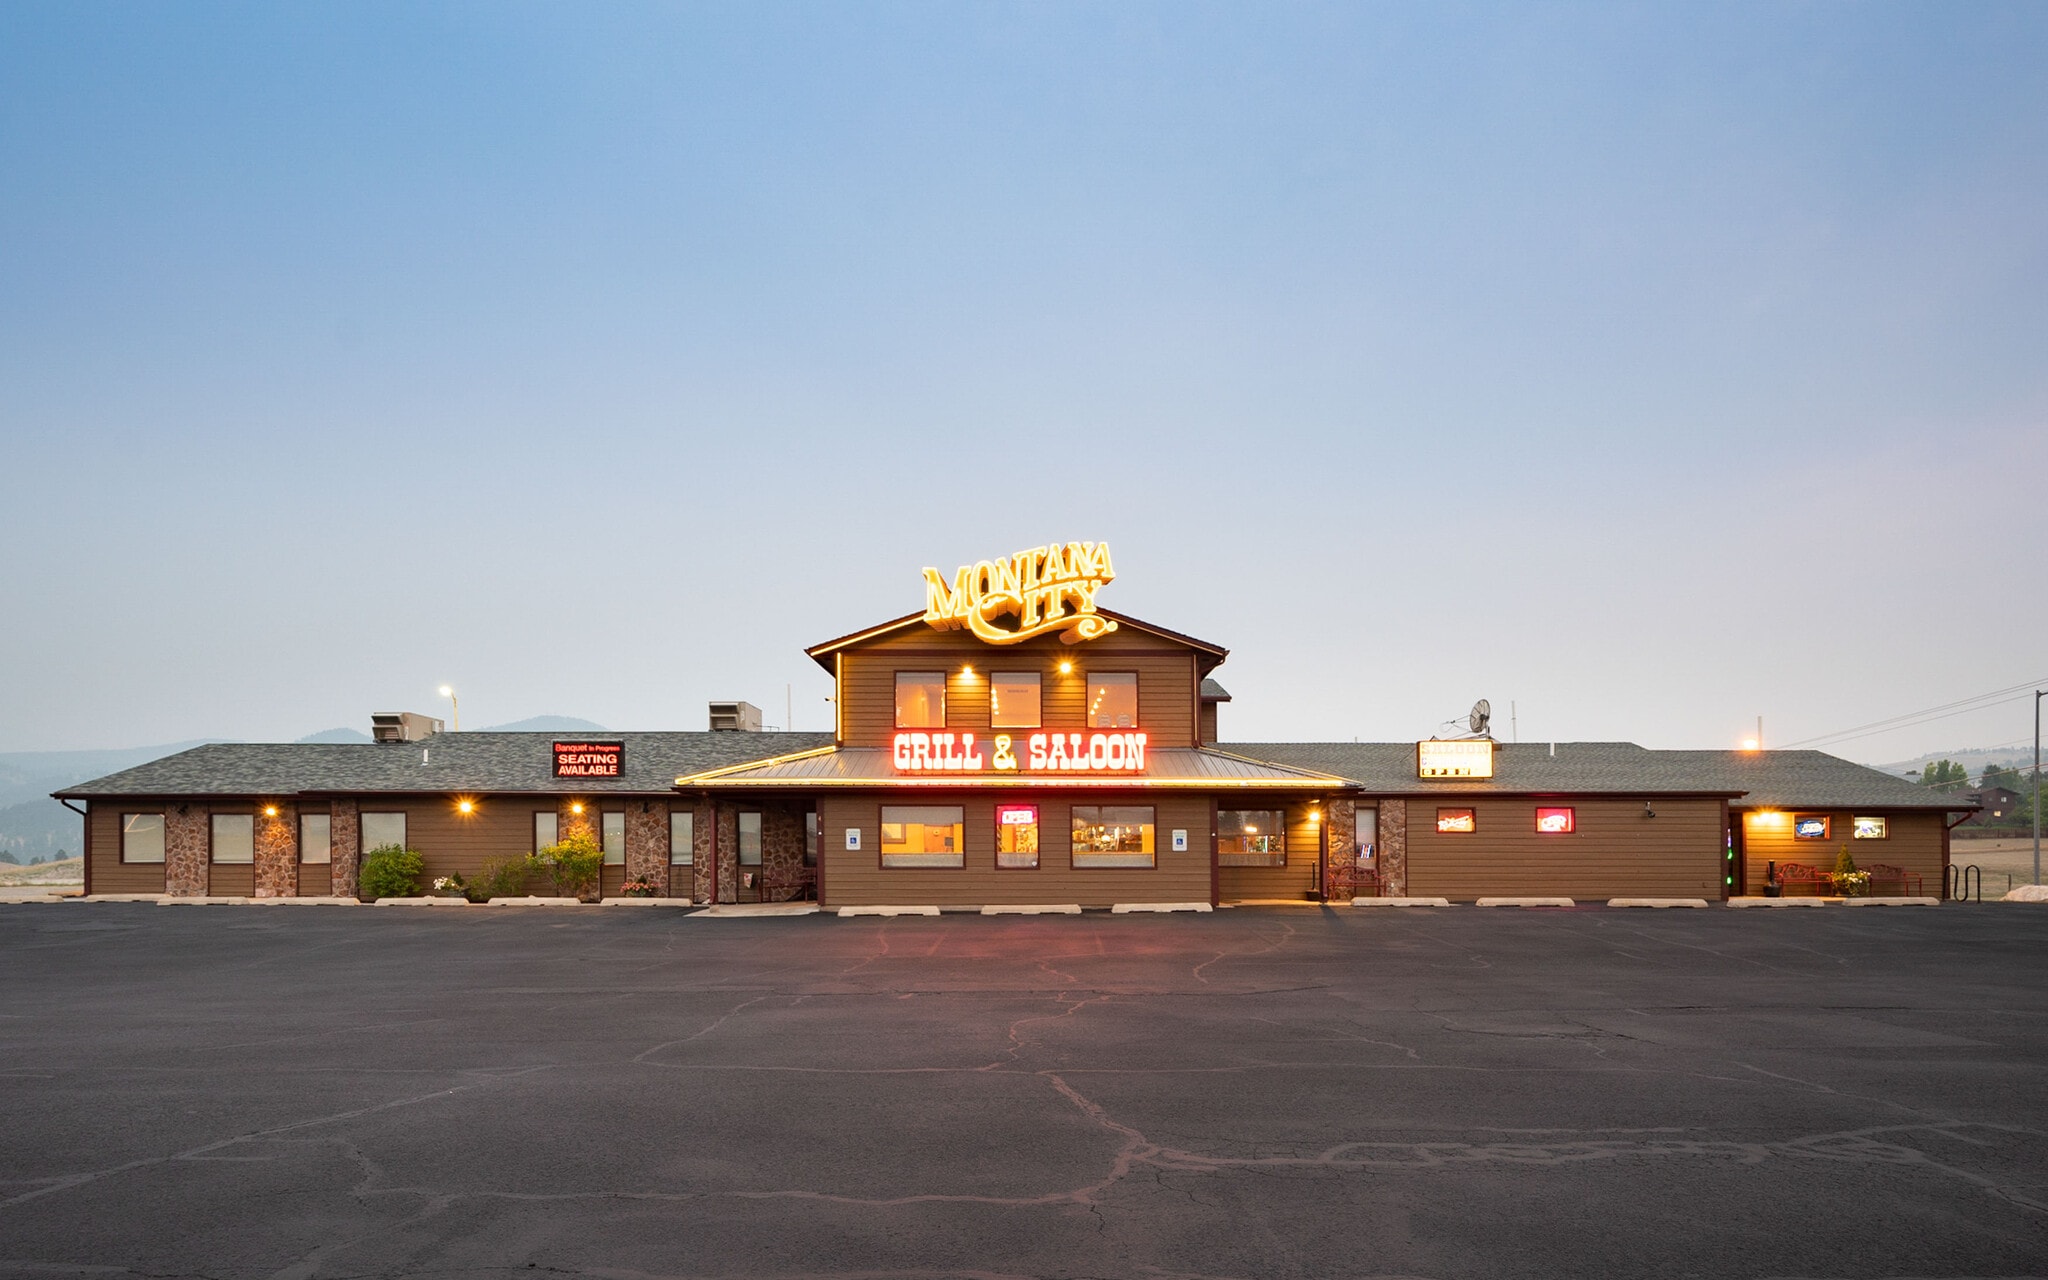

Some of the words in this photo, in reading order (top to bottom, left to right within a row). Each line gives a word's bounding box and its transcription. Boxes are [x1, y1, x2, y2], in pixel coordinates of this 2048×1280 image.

[922, 541, 1116, 624] MONTANA
[968, 580, 1118, 645] CITY
[555, 744, 587, 753] Banquet
[558, 754, 617, 764] SEATING
[893, 733, 983, 770] GRILL
[992, 734, 1017, 770] &
[1029, 733, 1147, 770] SALOON
[558, 765, 617, 775] AVAILABLE
